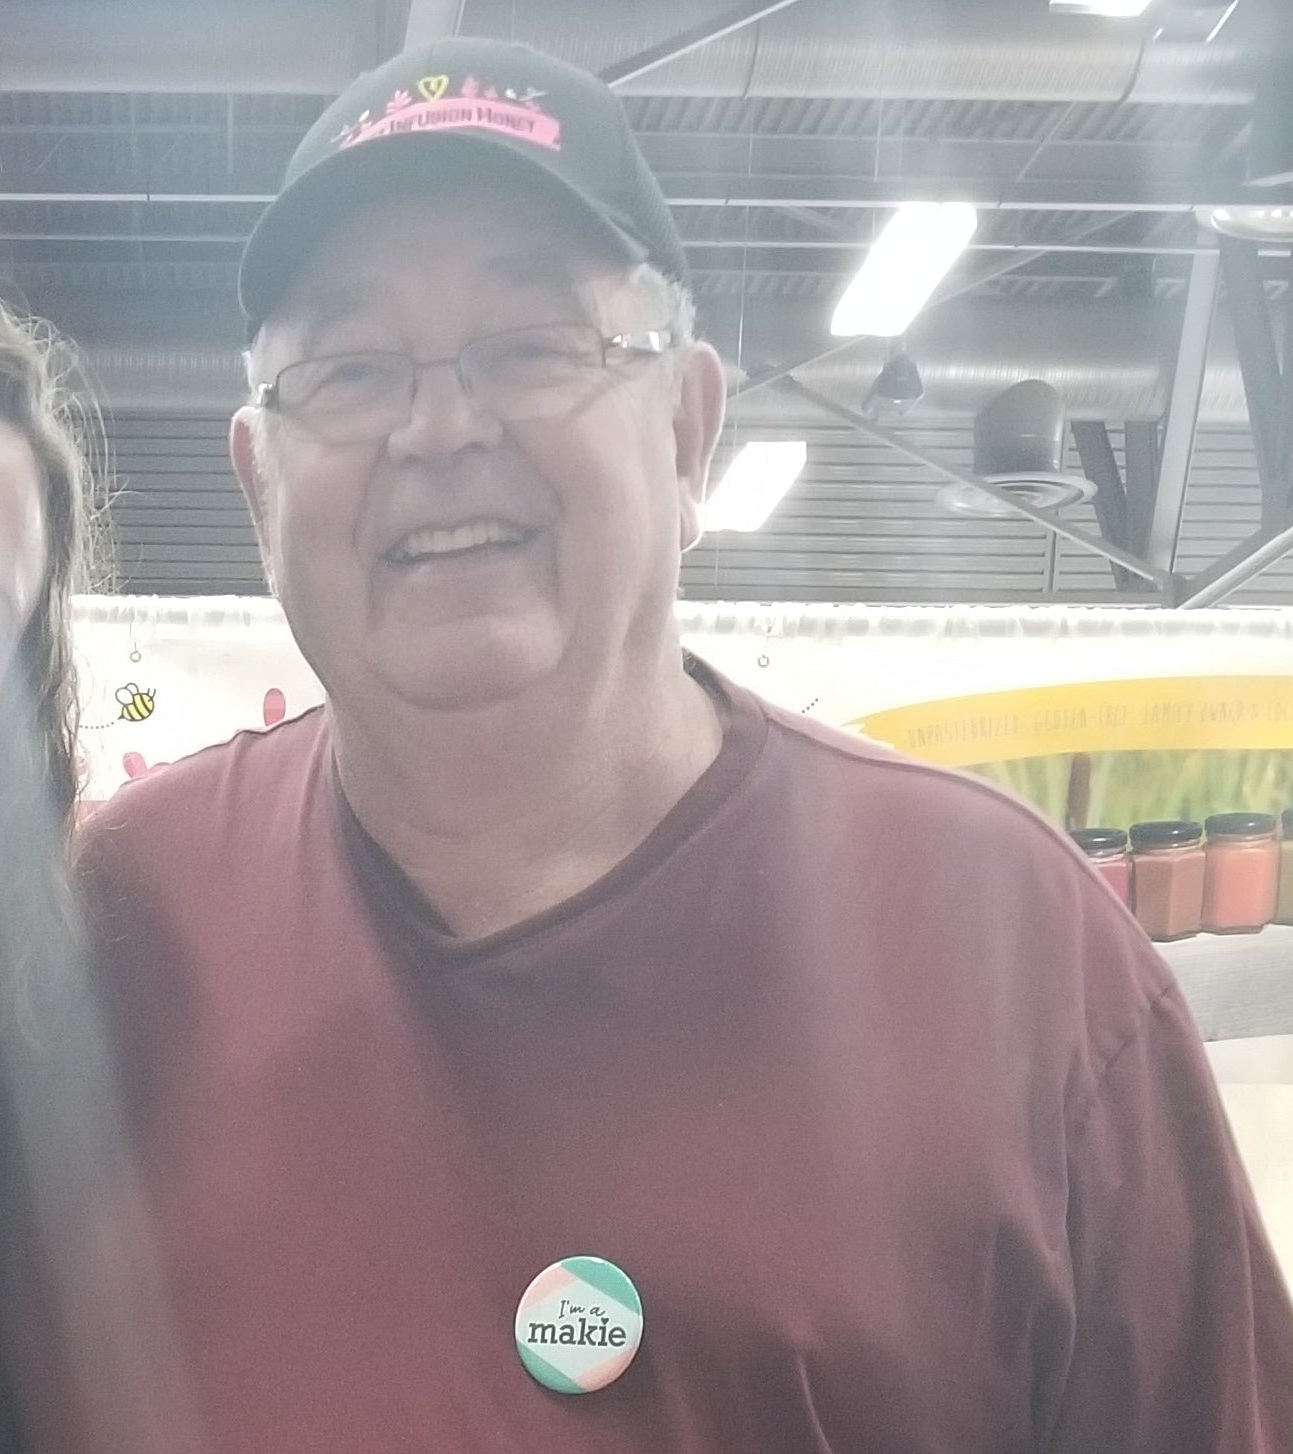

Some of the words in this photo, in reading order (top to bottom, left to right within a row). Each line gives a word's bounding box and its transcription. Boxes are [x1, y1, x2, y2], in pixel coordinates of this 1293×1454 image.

[477, 108, 535, 132] HONEY
[1268, 699, 1293, 722] LOC
[558, 1300, 585, 1319] I'm
[589, 1305, 606, 1318] a
[528, 1317, 626, 1347] makie
